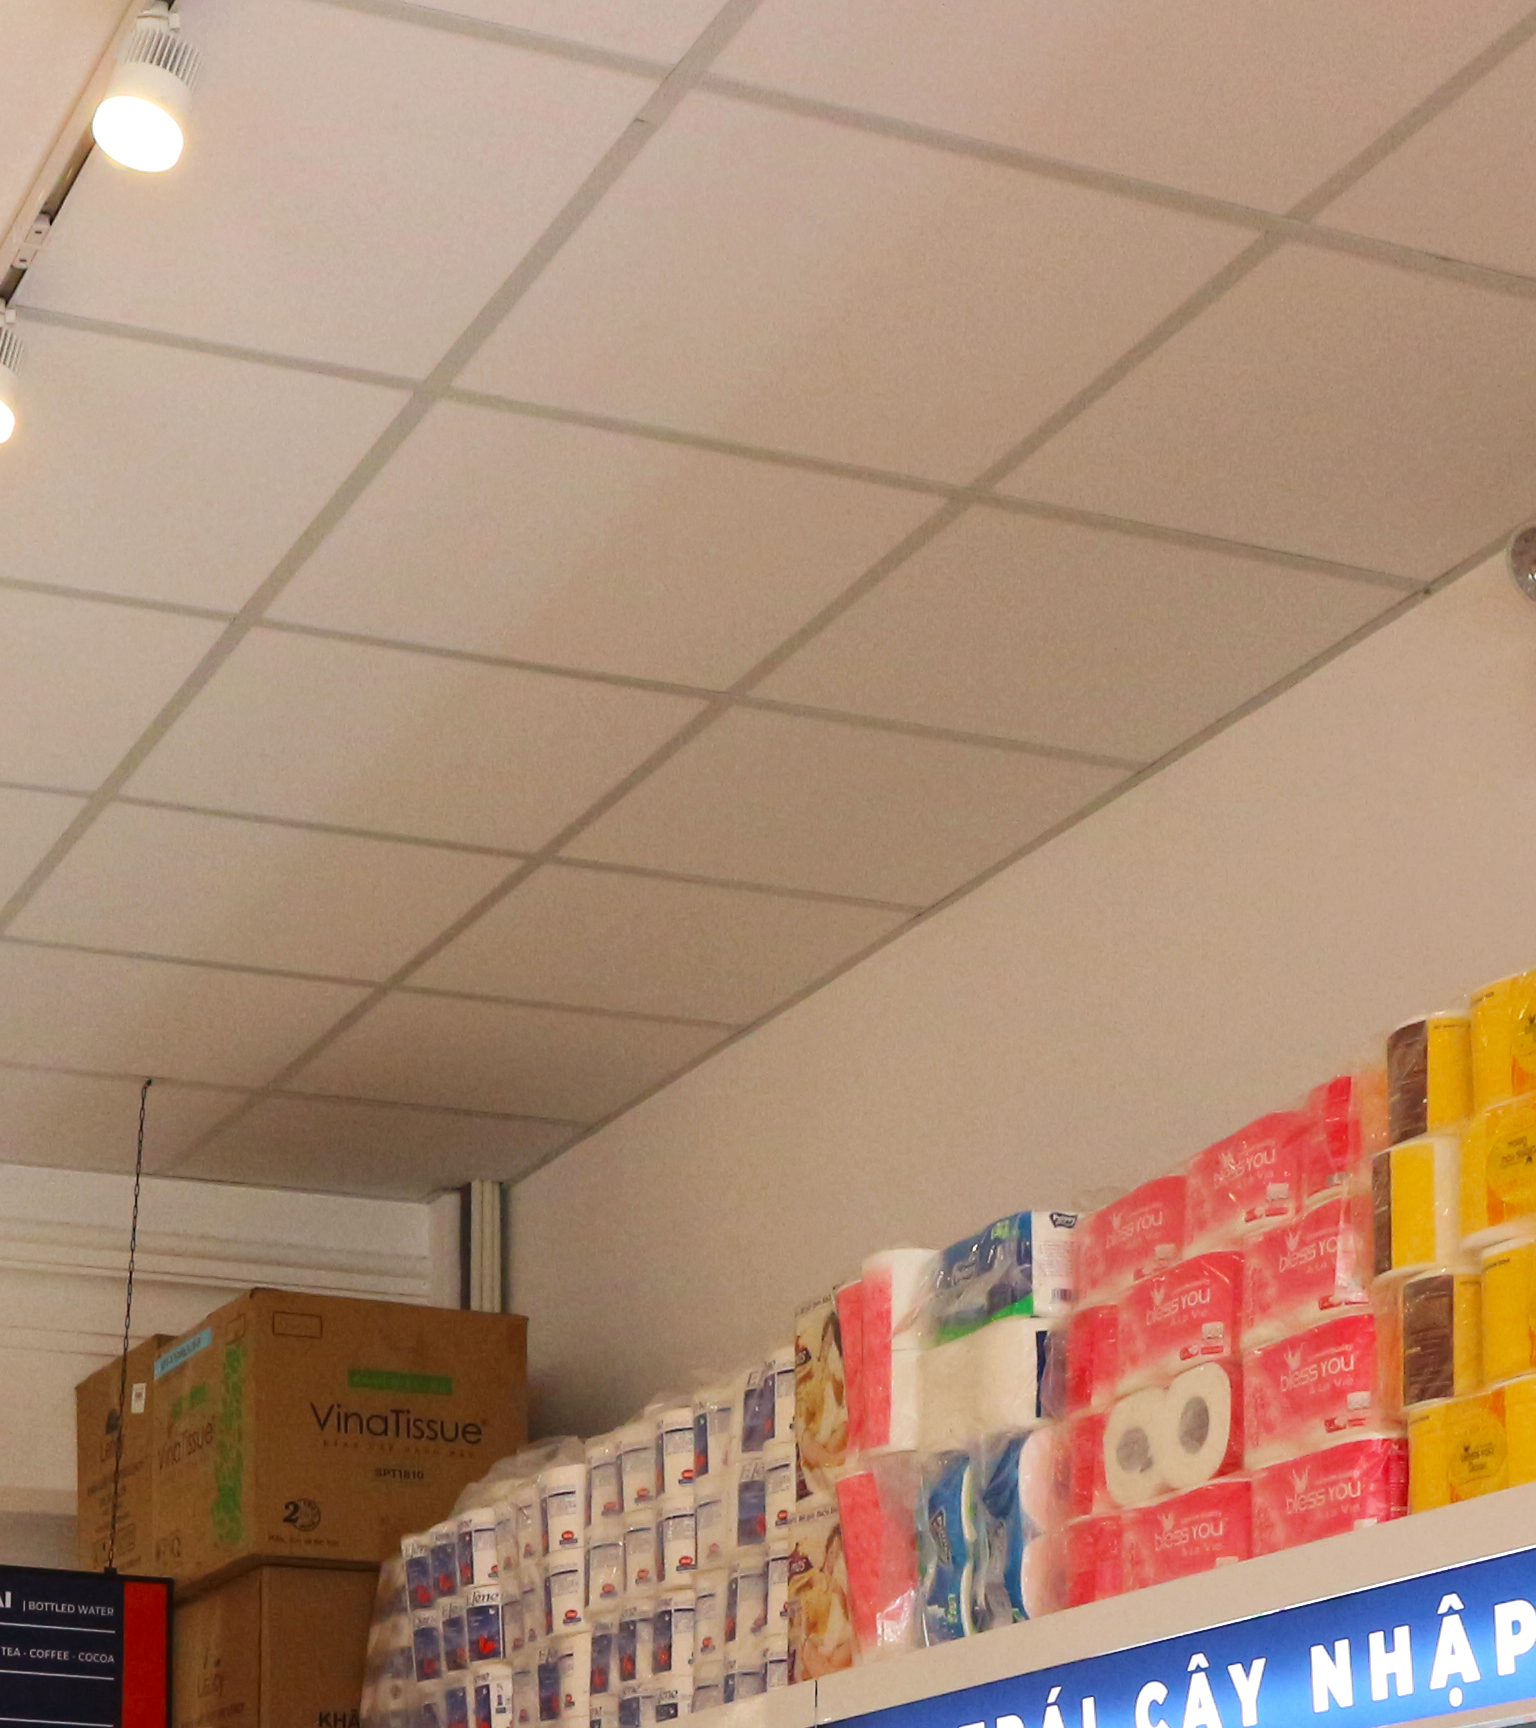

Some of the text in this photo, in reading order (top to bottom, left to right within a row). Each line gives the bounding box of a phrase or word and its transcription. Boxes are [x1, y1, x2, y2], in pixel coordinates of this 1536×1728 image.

[1319, 1354, 1355, 1378] YOU
[310, 1402, 483, 1446] VinaTissue
[1328, 1480, 1362, 1501] YOU
[1190, 1520, 1224, 1541] YOU
[29, 1601, 74, 1615] BOTTLED
[76, 1604, 115, 1617] WATER
[1, 1646, 21, 1658] TEA
[30, 1648, 69, 1662] COFFEE
[78, 1651, 115, 1664] COCOA
